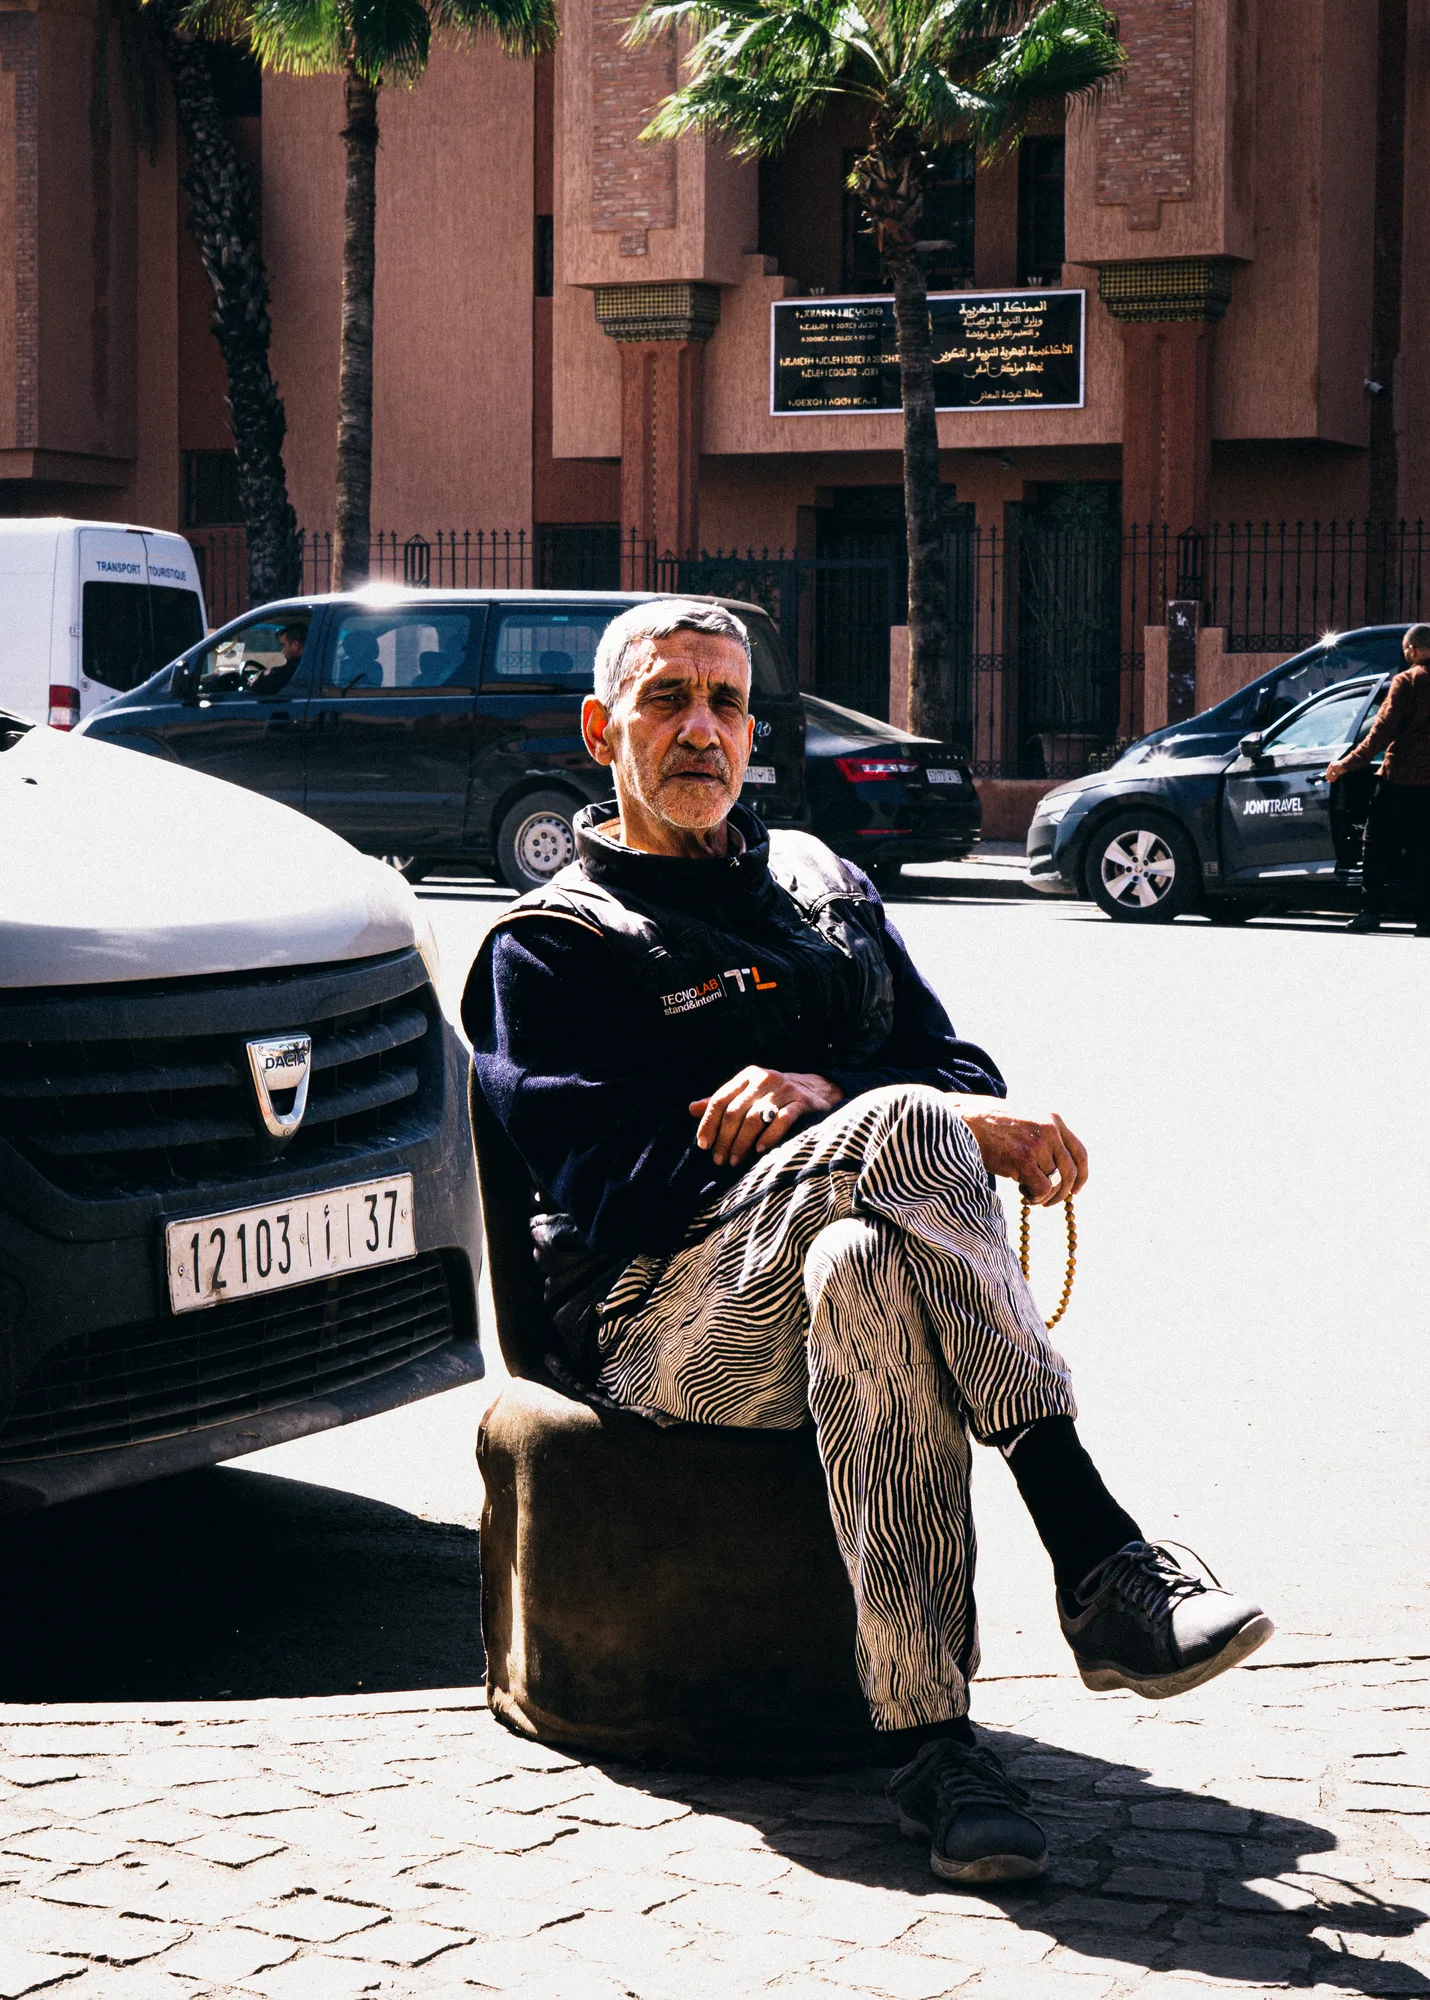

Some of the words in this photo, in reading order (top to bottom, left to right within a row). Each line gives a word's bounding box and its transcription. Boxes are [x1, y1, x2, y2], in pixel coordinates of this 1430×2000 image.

[959, 302, 1000, 318] المغربية
[1002, 300, 1047, 313] المملكة
[962, 317, 995, 328] الوطنية
[996, 315, 1021, 328] التربية
[1020, 316, 1043, 328] وزارة
[932, 348, 968, 364] التكوين
[976, 347, 999, 361] للتربية
[1000, 346, 1027, 361] الجهوية
[1028, 344, 1073, 357] الأكاديمية
[988, 362, 1024, 378] مراكش
[1025, 361, 1044, 374] لجهة
[1001, 389, 1022, 402] عرصة
[1024, 388, 1043, 399] ملحقة
[96, 560, 141, 575] TRANSPORT
[148, 566, 187, 581] TOURISTIQUE
[660, 978, 719, 1006] TECNOLAB
[664, 988, 723, 1016] stand&interni
[265, 1053, 306, 1070] DACIA
[191, 1214, 292, 1294] 12103
[365, 1190, 398, 1252] 37
